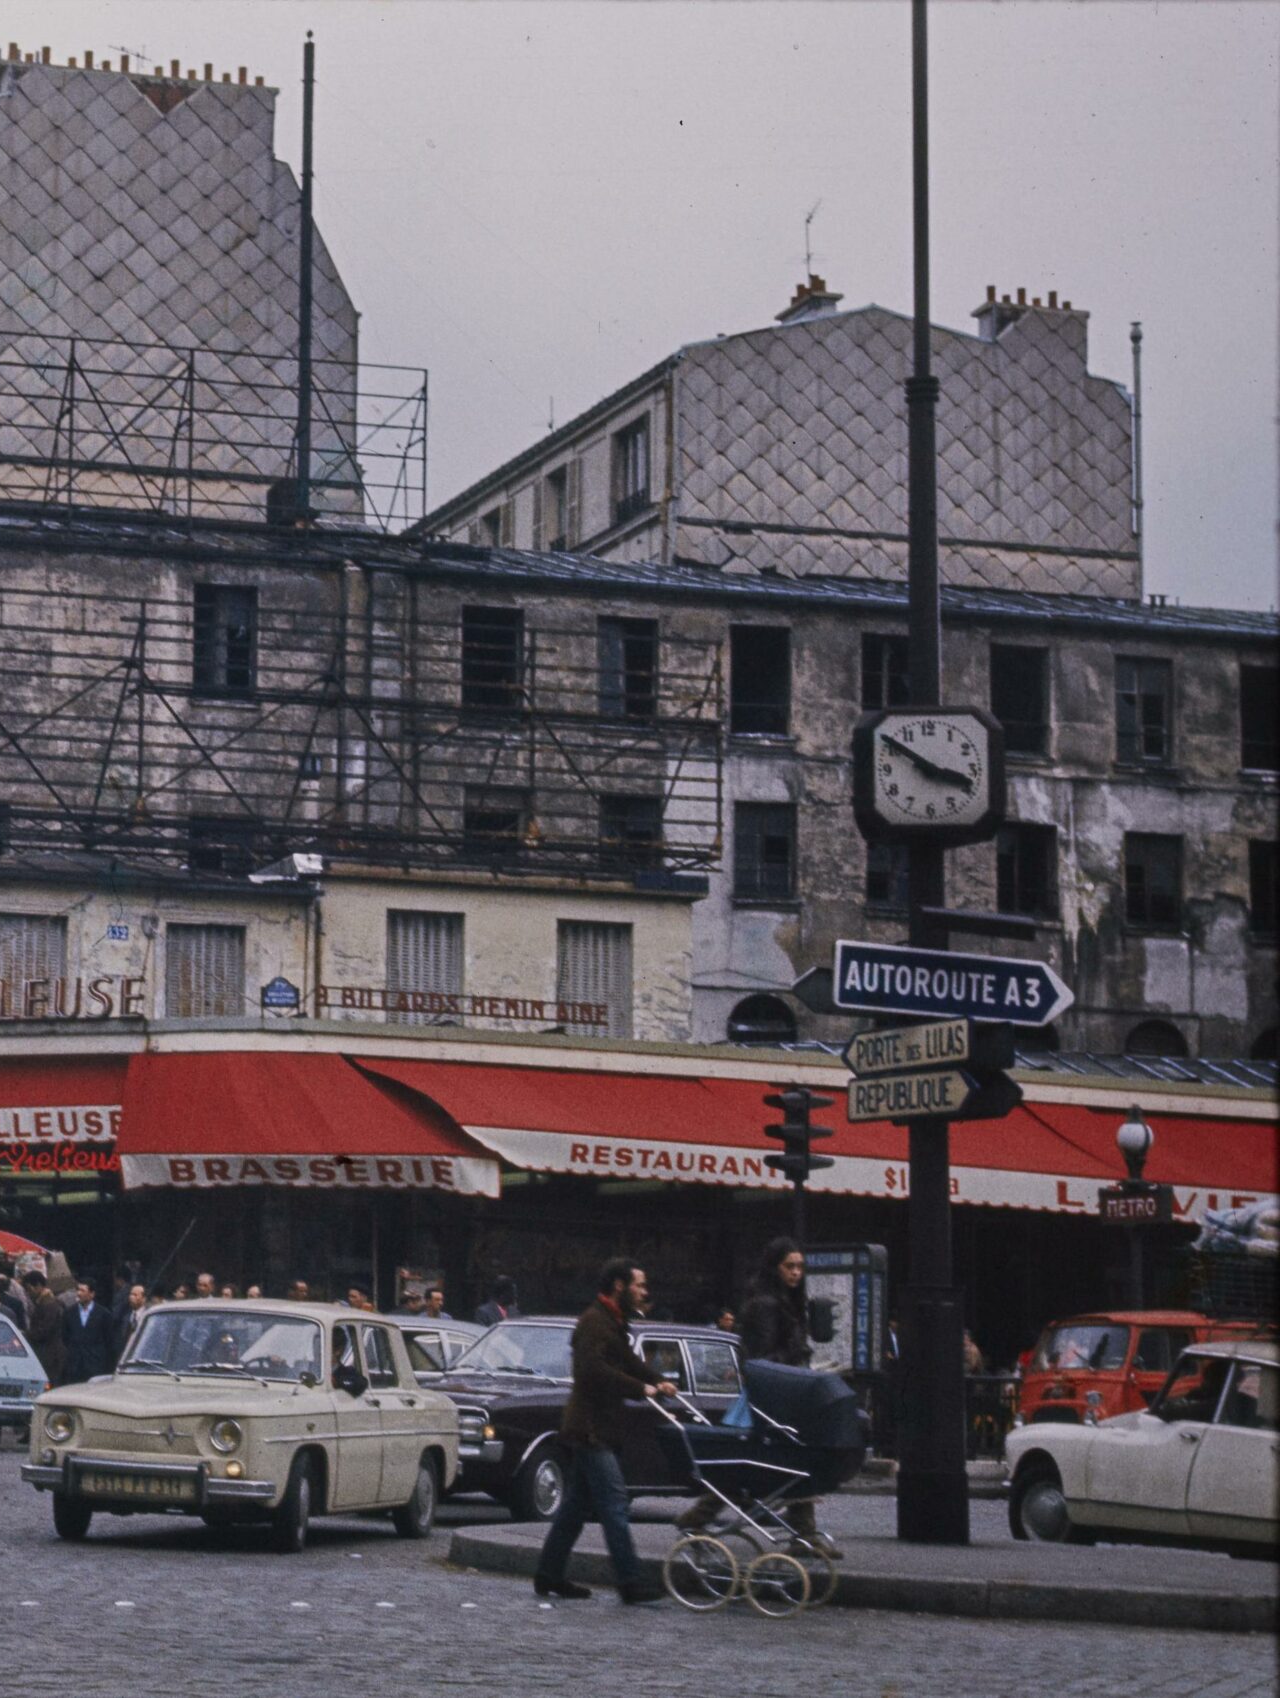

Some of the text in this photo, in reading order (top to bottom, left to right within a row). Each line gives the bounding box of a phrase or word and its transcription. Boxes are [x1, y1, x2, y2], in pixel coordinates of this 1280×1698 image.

[341, 987, 460, 1014] BILLARDS
[844, 960, 1041, 1008] AUTOROUTE A3
[856, 1034, 901, 1074] PORTE
[925, 1025, 964, 1058] LILAS
[2, 1141, 121, 1174] Vielleus
[168, 1156, 455, 1187] BRASSERIE
